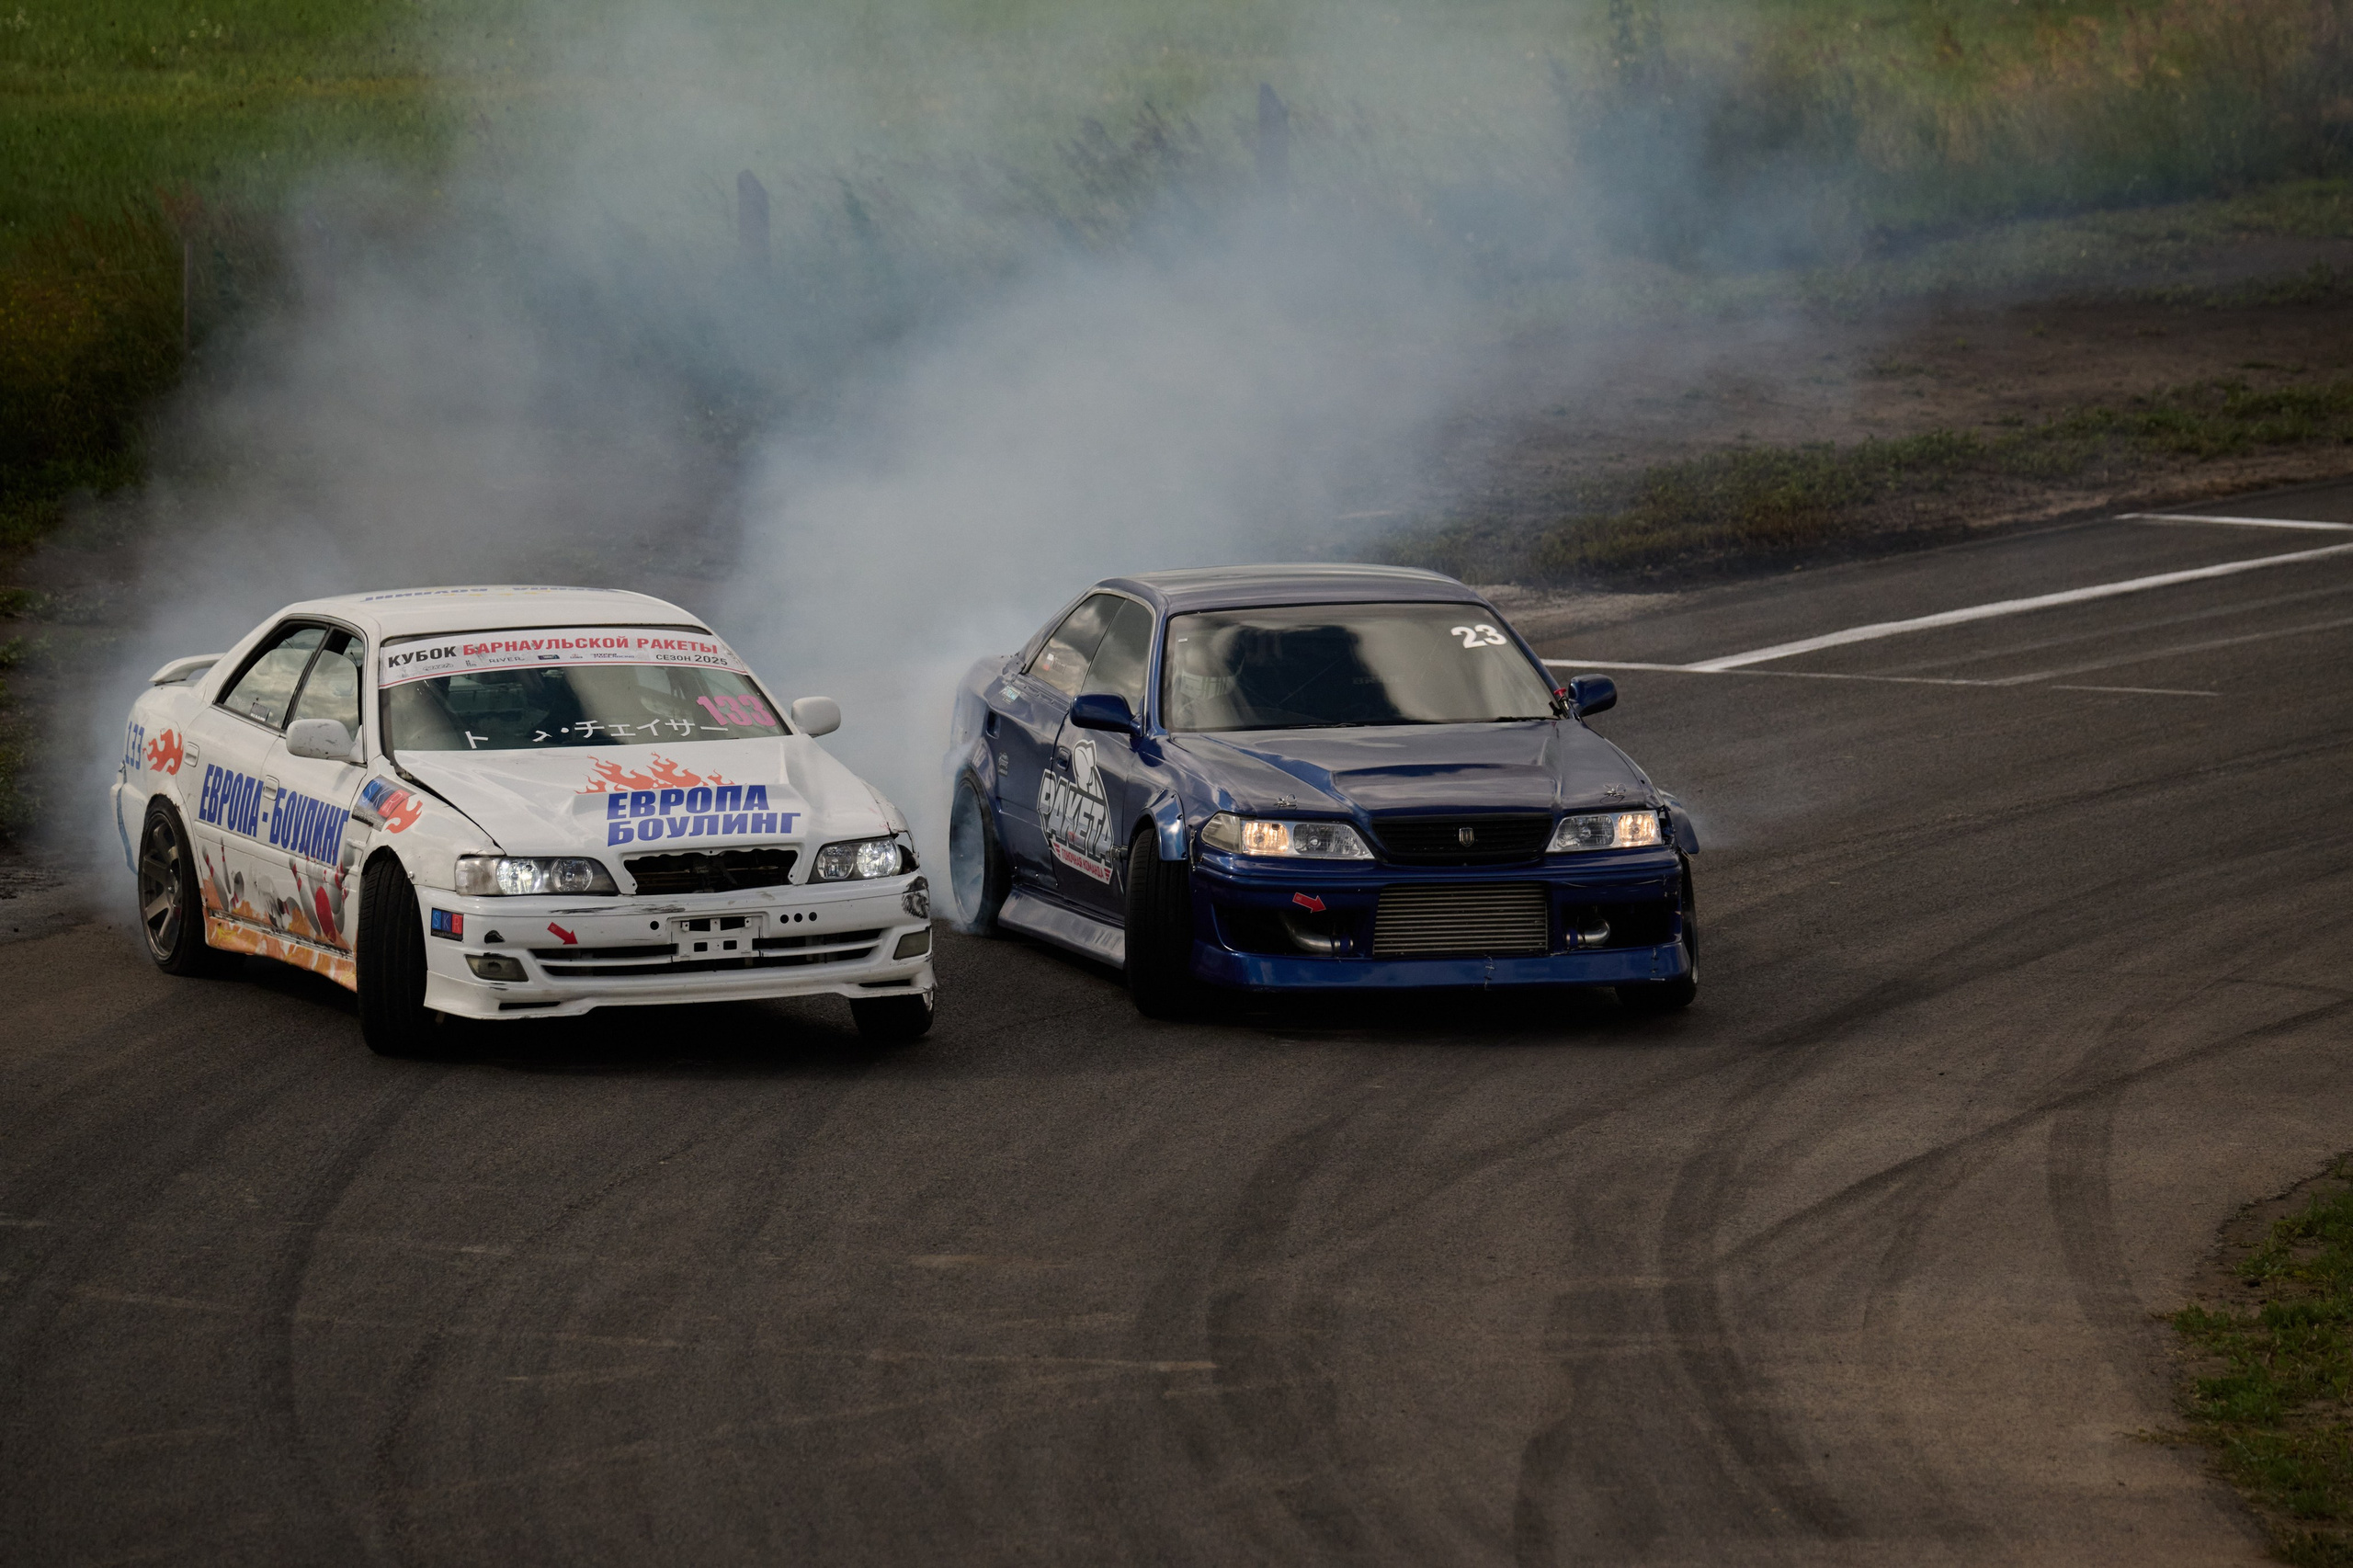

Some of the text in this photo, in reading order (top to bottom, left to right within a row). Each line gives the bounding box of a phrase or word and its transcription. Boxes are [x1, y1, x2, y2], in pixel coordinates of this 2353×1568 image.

[388, 646, 457, 668] КУБОК
[462, 635, 627, 656] БАРНАУЛЬСКОЙ
[637, 638, 718, 654] РАКЕТЫ
[1450, 624, 1507, 649] 23
[655, 653, 728, 666] СЕЗОН 2025
[696, 694, 777, 727] 133
[125, 721, 145, 771] 133
[361, 779, 404, 813] SKR
[607, 784, 770, 821] ЕВРОПА
[199, 763, 265, 838] ЕВРОПА
[269, 787, 351, 867] БОУЛИНГ
[607, 812, 801, 847] БОУЛИНГ
[1038, 772, 1113, 866] РАКЕТА
[434, 912, 460, 932] SKR
